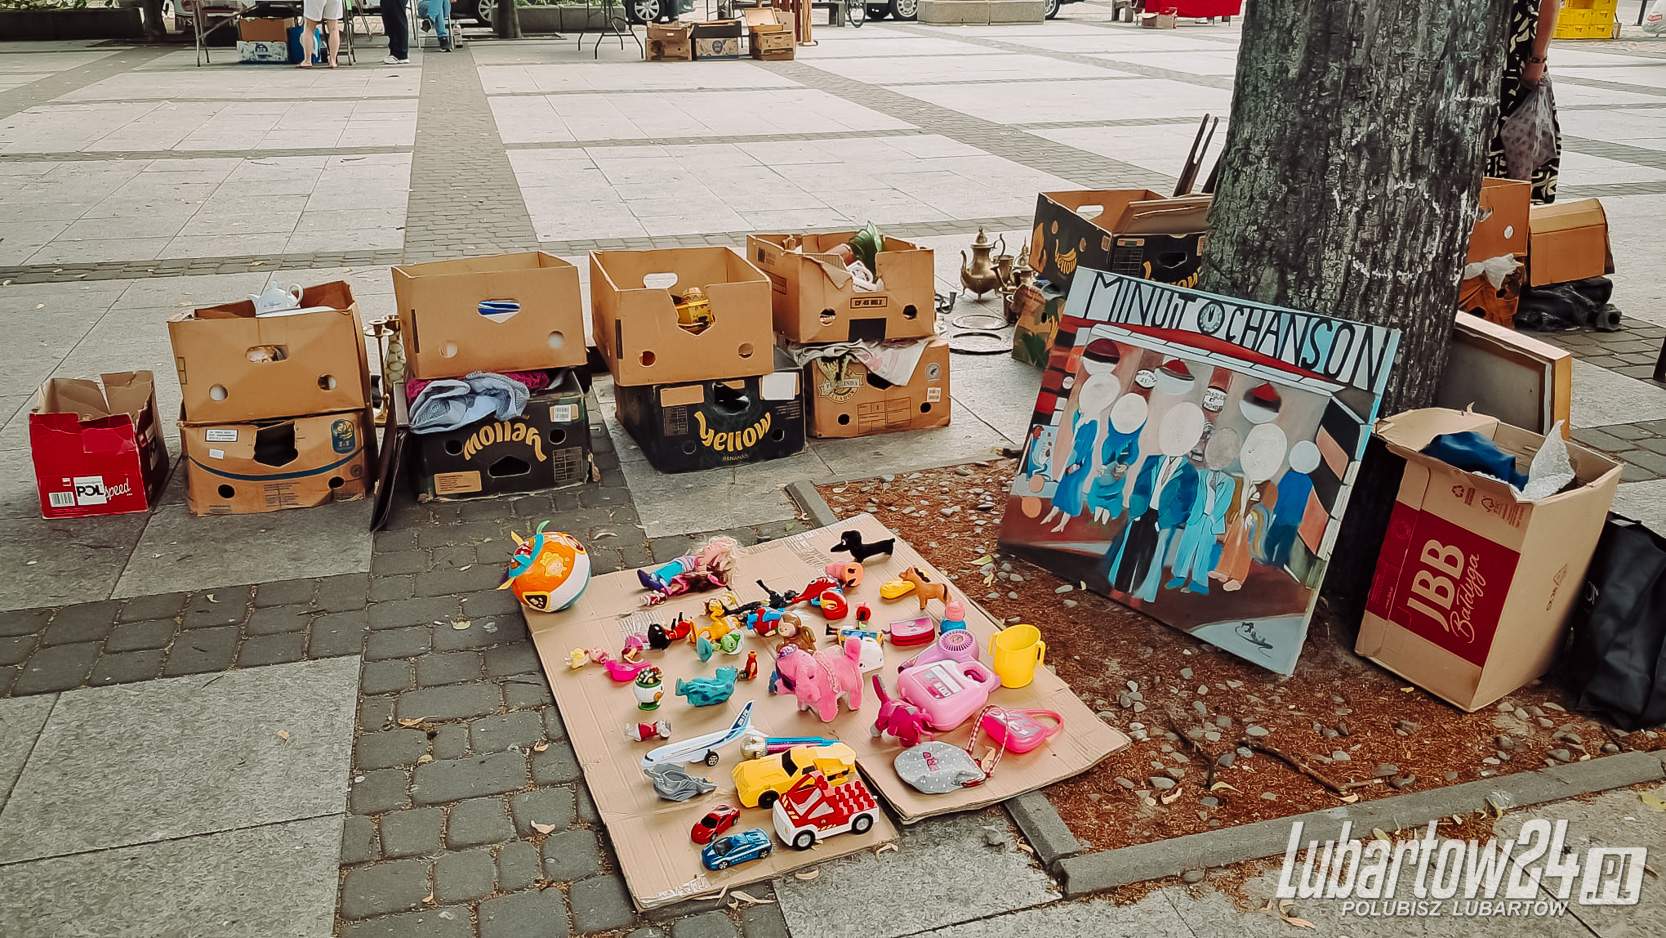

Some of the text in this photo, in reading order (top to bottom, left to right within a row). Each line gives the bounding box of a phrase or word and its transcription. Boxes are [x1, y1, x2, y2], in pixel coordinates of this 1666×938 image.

[1083, 271, 1391, 391] MINUIT CHANSON
[1406, 539, 1465, 633] JBB
